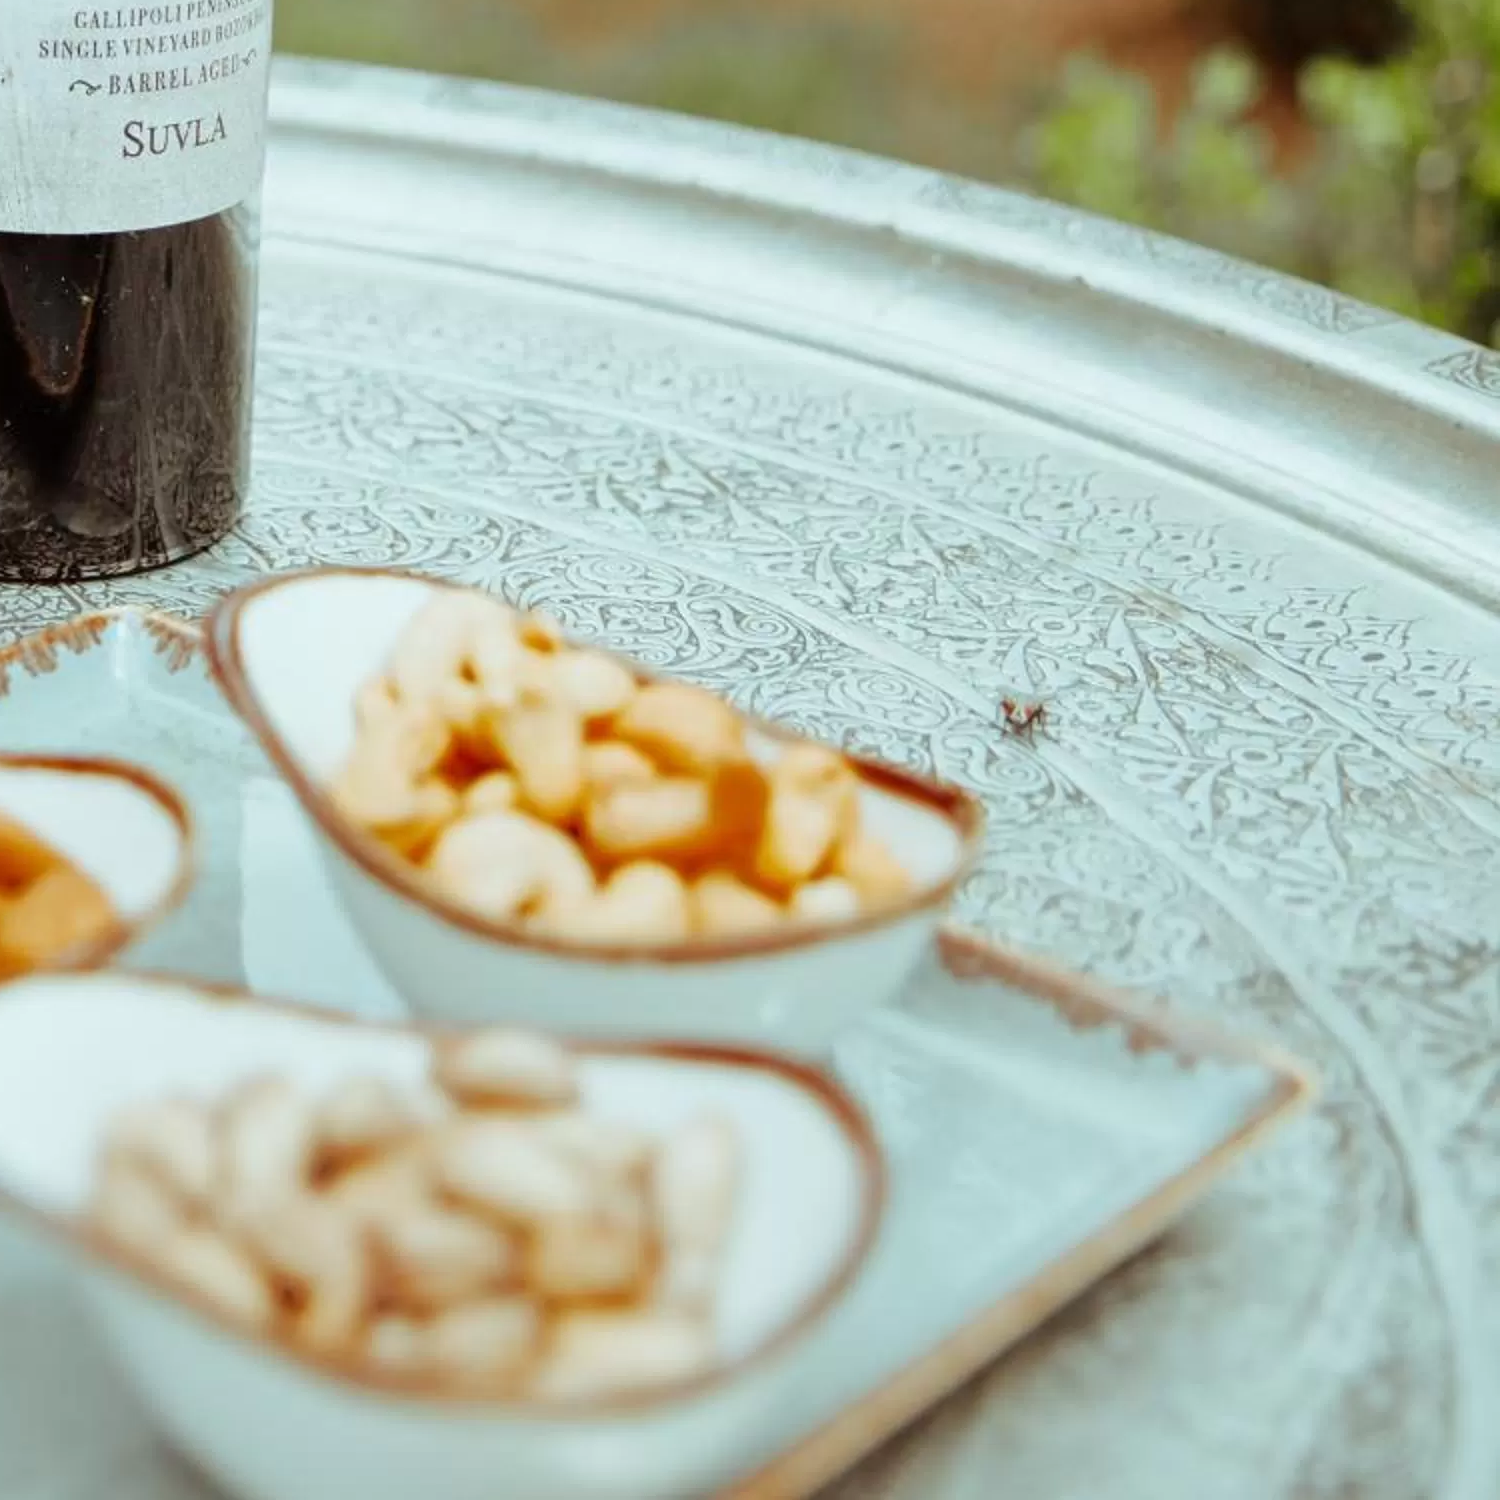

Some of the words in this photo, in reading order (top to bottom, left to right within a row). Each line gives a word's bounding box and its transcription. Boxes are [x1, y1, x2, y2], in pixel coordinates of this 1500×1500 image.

[74, 5, 182, 29] GALLIPOLI
[38, 39, 117, 60] SINGLE
[123, 29, 211, 57] VINEYARD
[109, 67, 194, 95] BARREL
[197, 52, 240, 85] AGED
[122, 111, 228, 159] SUVLA
